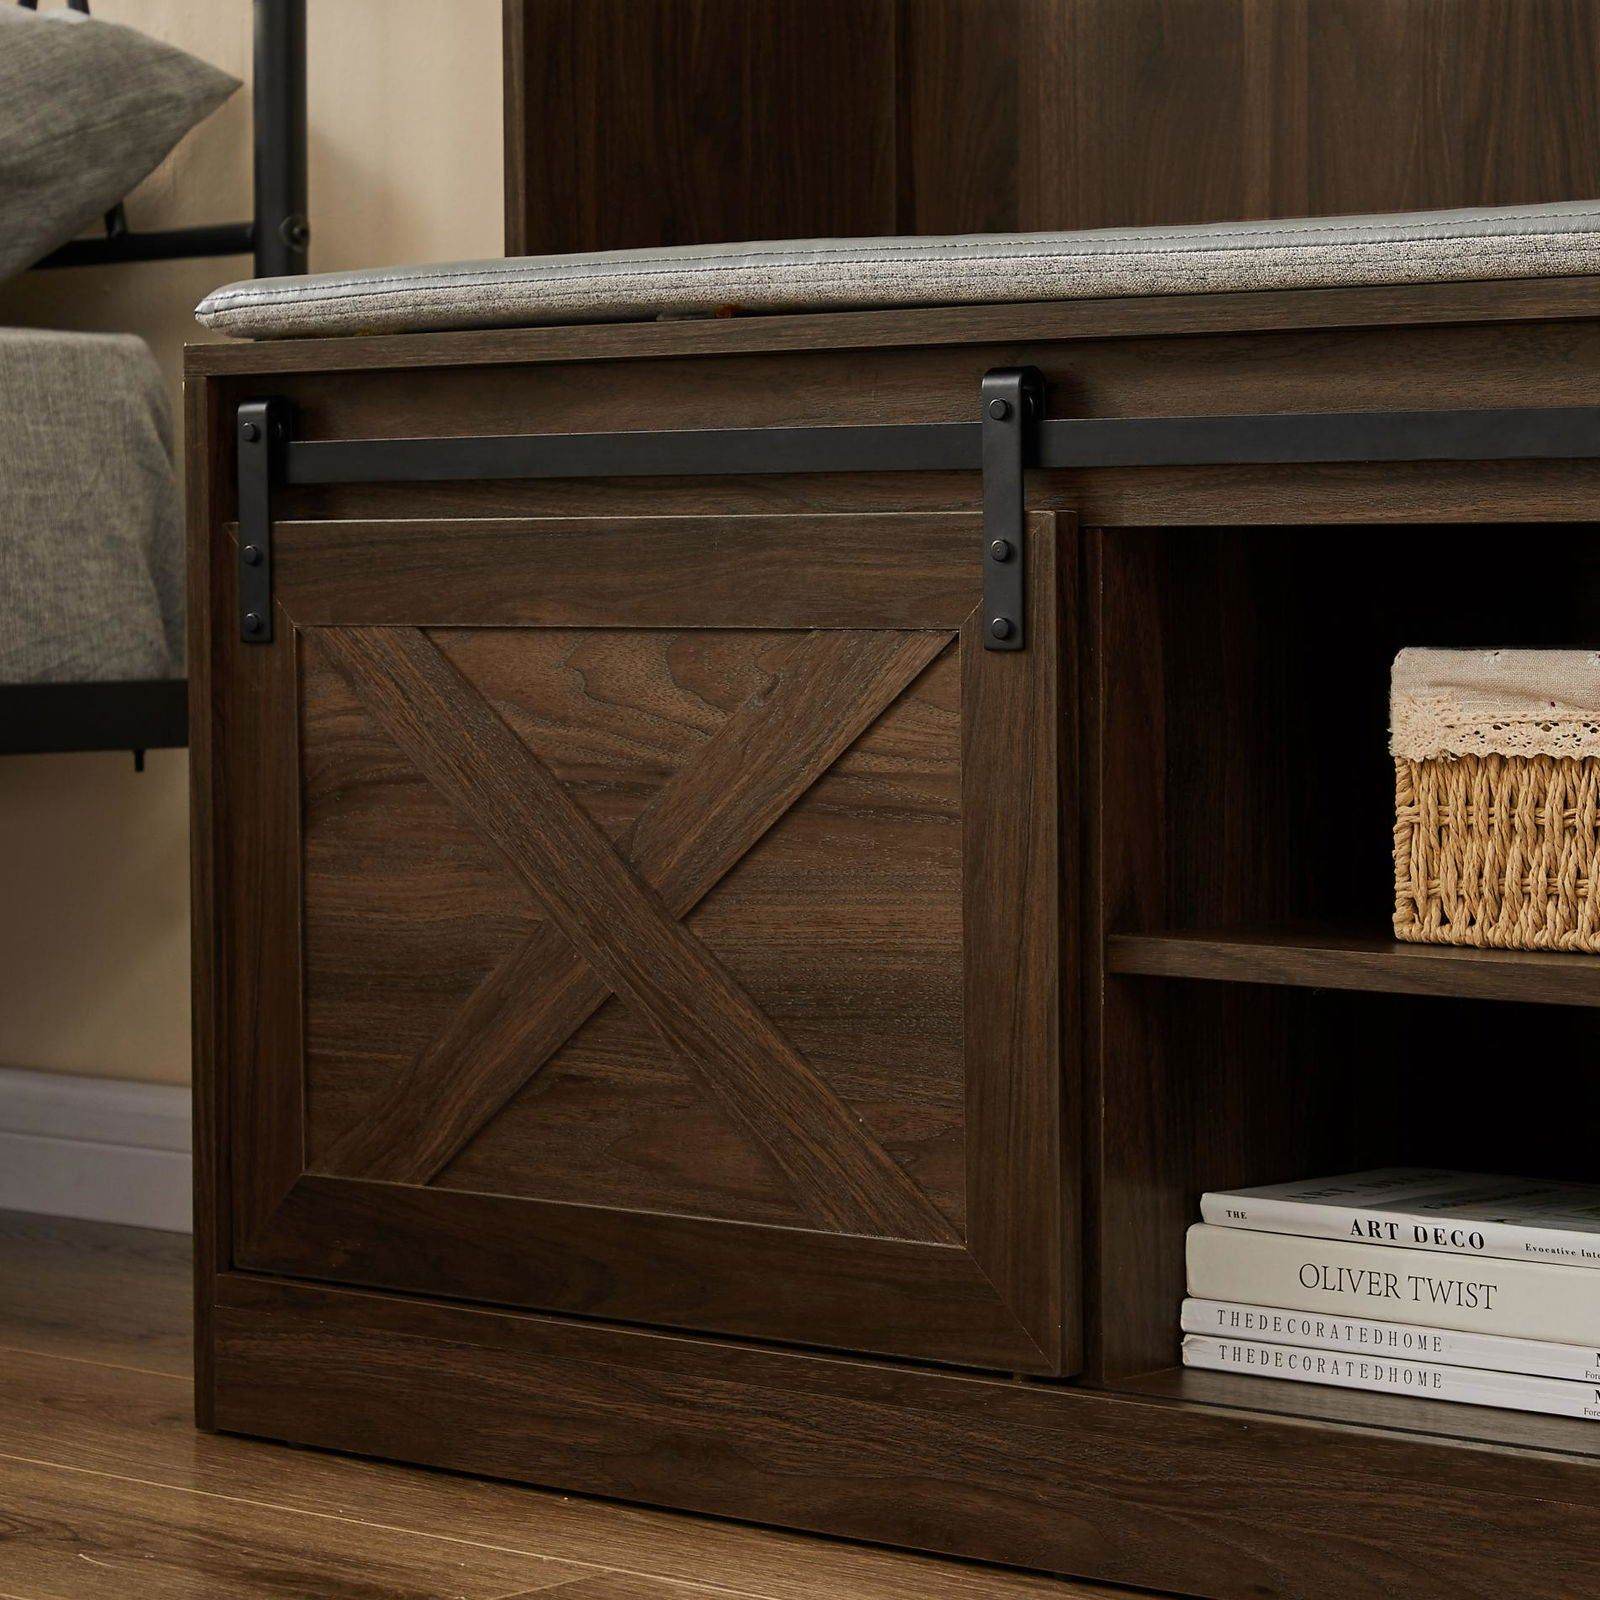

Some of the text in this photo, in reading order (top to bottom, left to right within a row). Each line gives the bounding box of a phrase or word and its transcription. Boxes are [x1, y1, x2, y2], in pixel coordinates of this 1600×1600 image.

[1226, 1209, 1248, 1220] THE
[1350, 1218, 1485, 1250] ART DECO
[1525, 1243, 1577, 1256] Evocative
[1299, 1263, 1498, 1310] OLIVER TWIST
